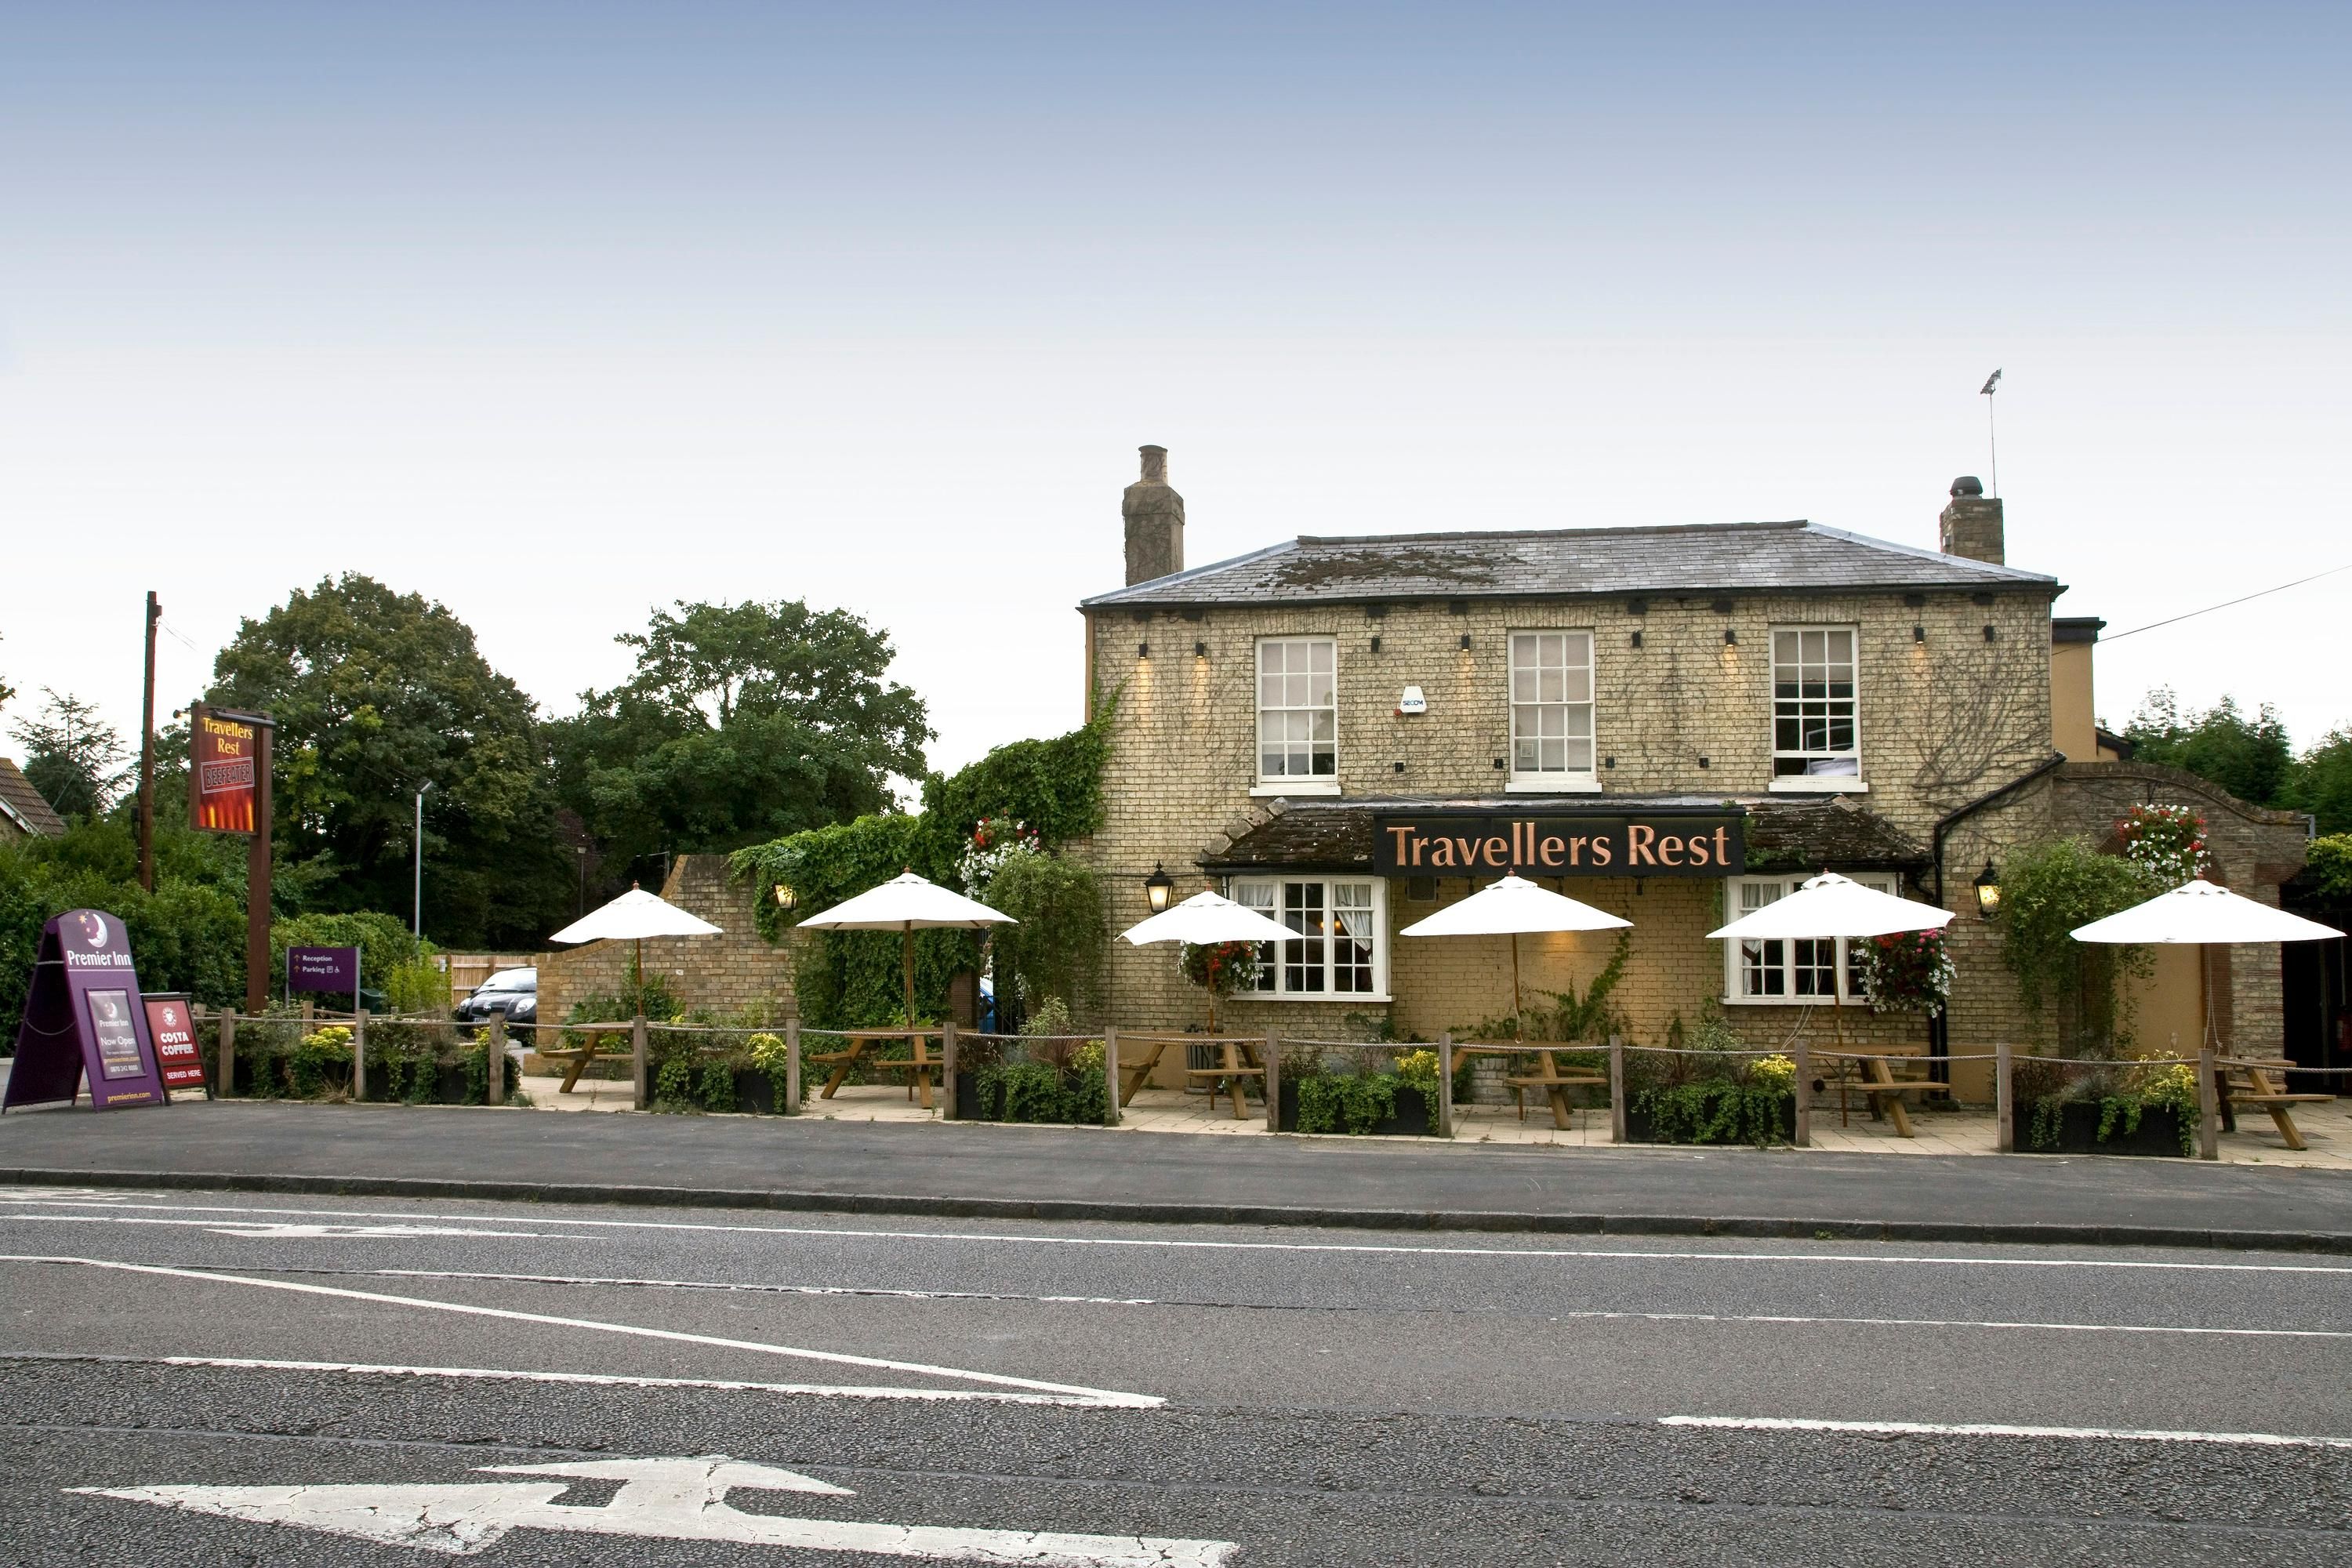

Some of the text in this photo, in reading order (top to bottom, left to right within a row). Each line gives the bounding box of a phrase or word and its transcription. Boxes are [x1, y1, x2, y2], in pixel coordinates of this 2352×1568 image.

[202, 717, 253, 740] Travellers
[217, 738, 240, 755] Rest
[205, 764, 252, 788] BEEFEATER
[1386, 822, 1731, 866] Travellers Rest
[67, 950, 132, 966] Premier Inn
[100, 1036, 136, 1047] Now Open
[160, 1031, 189, 1044] COSTA
[162, 1044, 194, 1056] COFFEE
[166, 1071, 187, 1080] SERVED
[107, 1092, 151, 1104] premierinn.com
